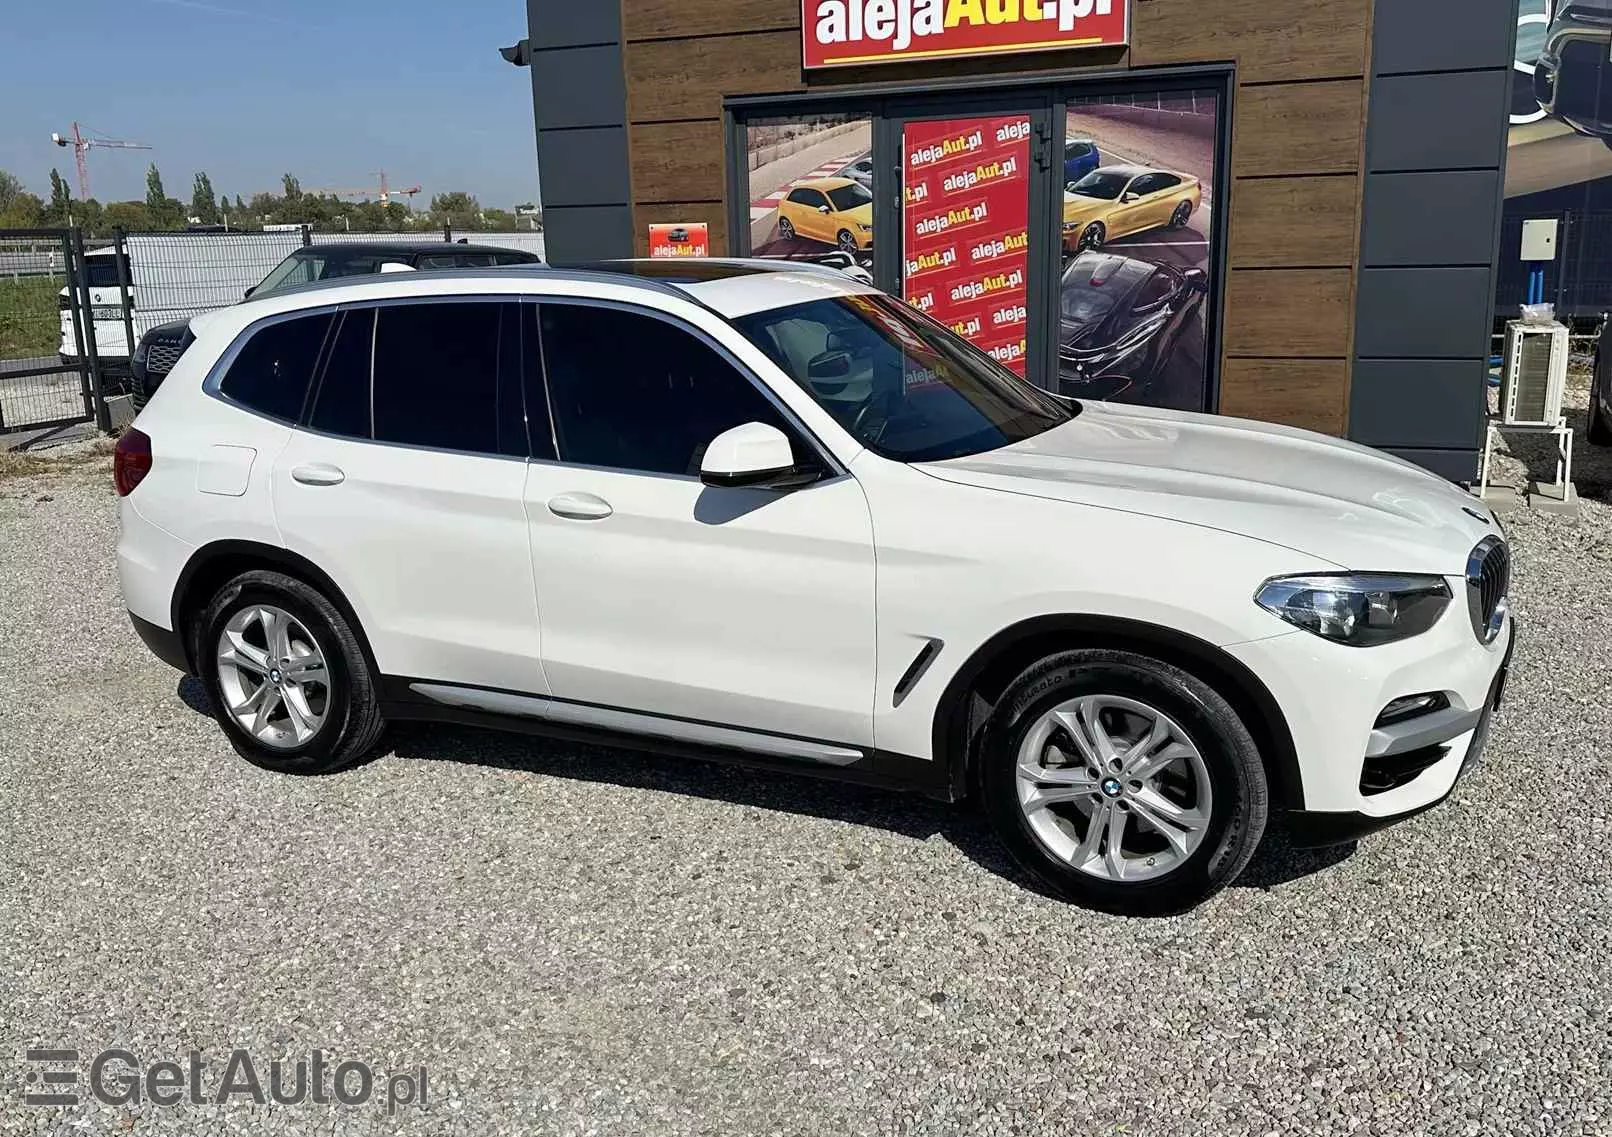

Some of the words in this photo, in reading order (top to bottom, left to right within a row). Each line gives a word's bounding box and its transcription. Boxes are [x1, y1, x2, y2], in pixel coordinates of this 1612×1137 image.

[816, 0, 1112, 50] alejau.p
[910, 131, 982, 165] alejaAut.pl
[943, 157, 1017, 191] alejaAut.pl
[905, 182, 928, 201] t.pl
[916, 202, 988, 234] alejaAut.pl
[653, 244, 705, 257] alejaAut.pl
[971, 232, 1028, 260] alejaAut
[951, 269, 1023, 300] alejaAut.pl
